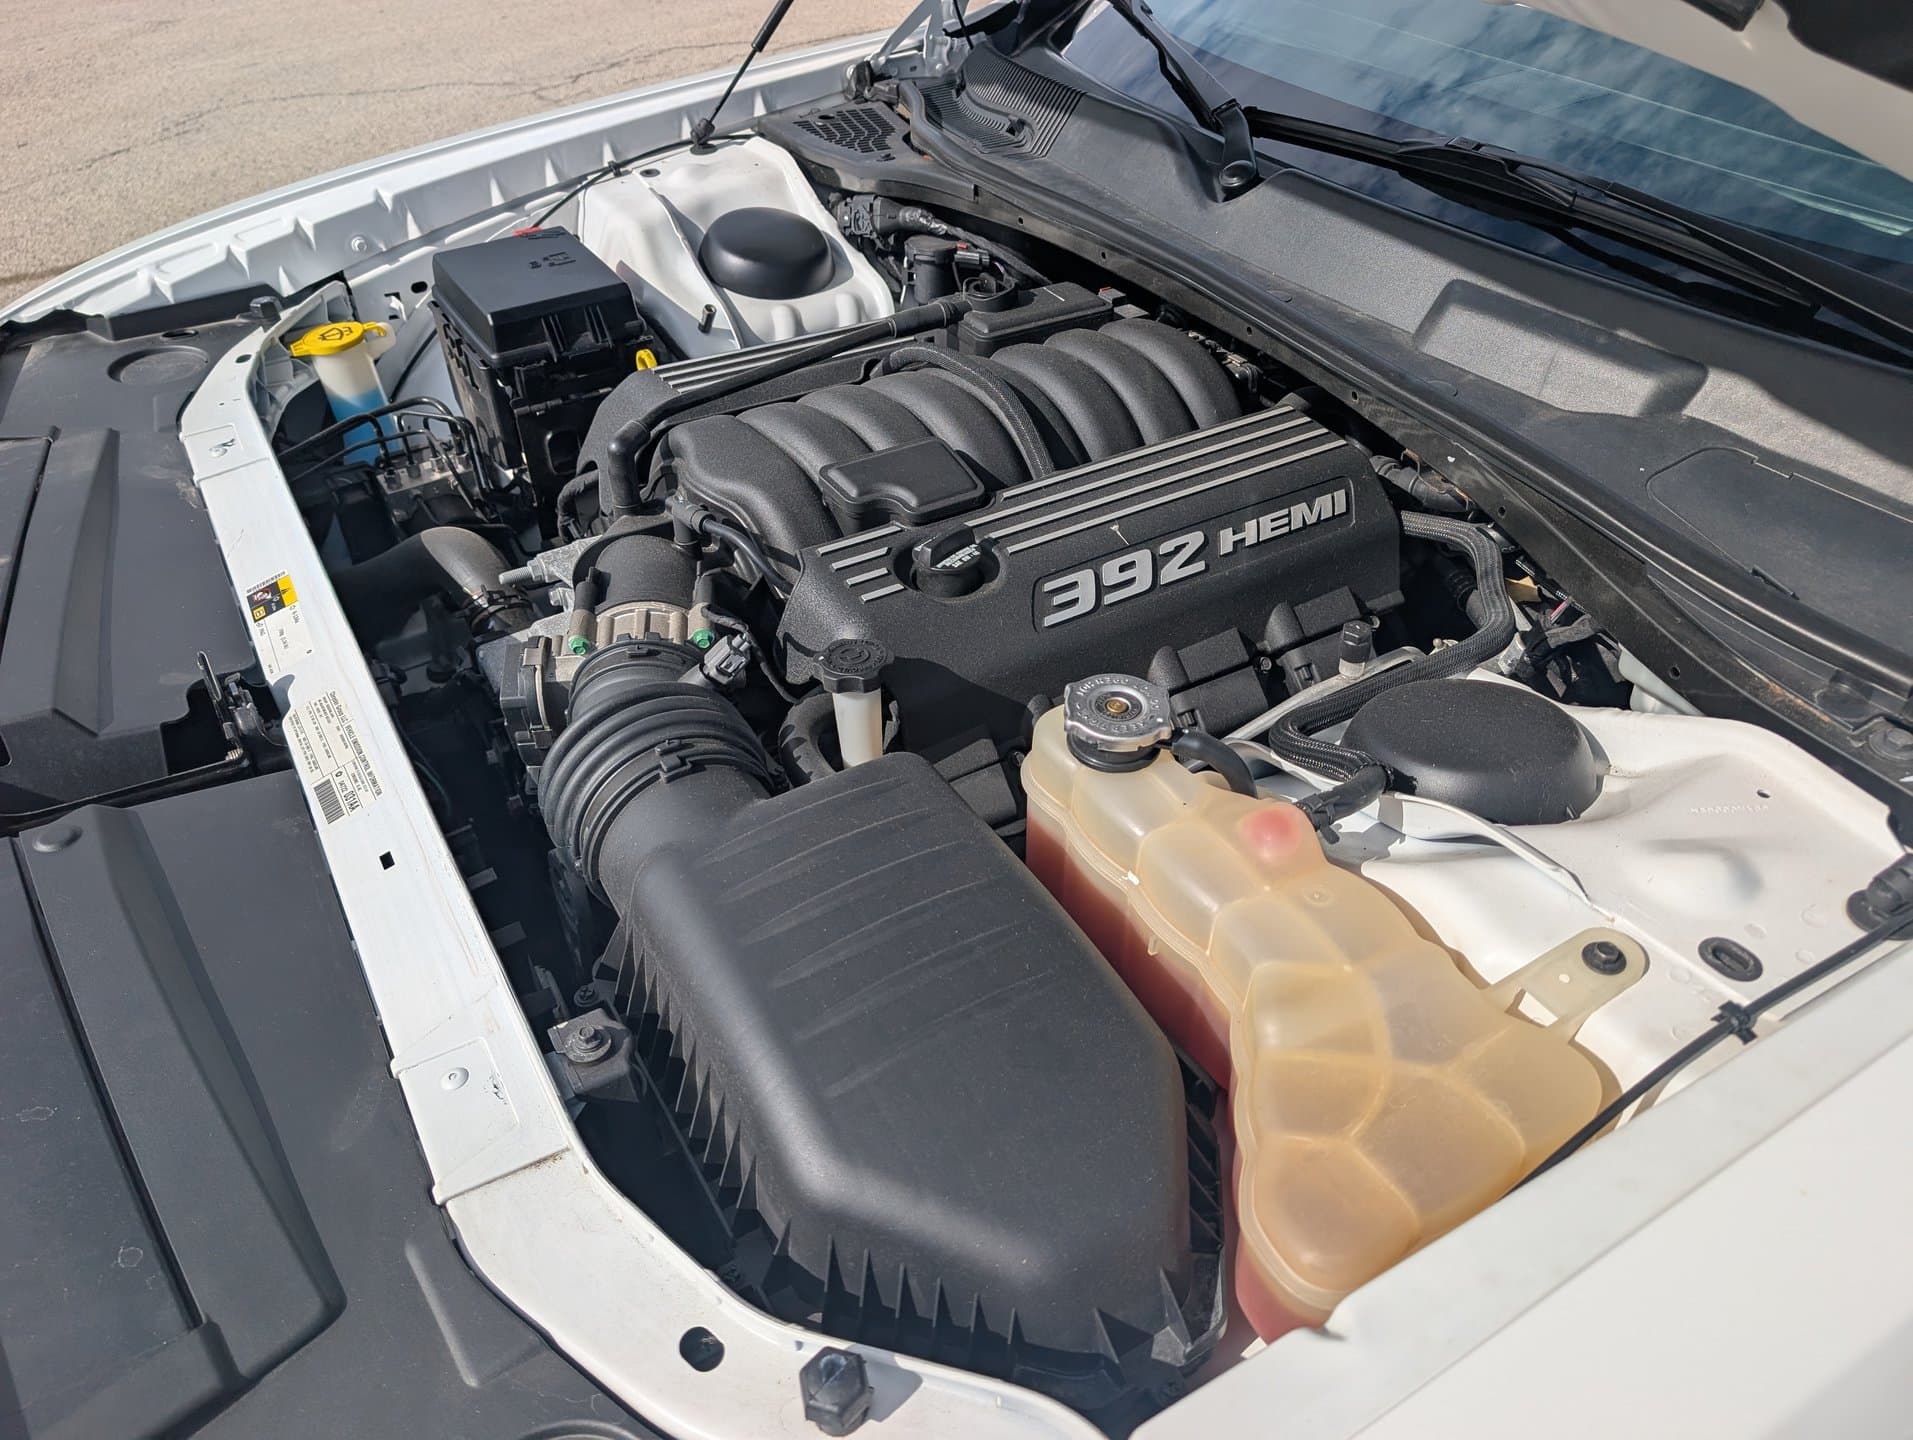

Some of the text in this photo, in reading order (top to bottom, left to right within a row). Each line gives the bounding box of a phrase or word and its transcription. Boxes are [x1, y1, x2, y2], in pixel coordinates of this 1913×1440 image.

[1043, 489, 1347, 627] 392 HEMI
[345, 724, 357, 740] VEHICLE
[359, 754, 371, 772] CONTROL
[367, 770, 382, 796] INFORMATION
